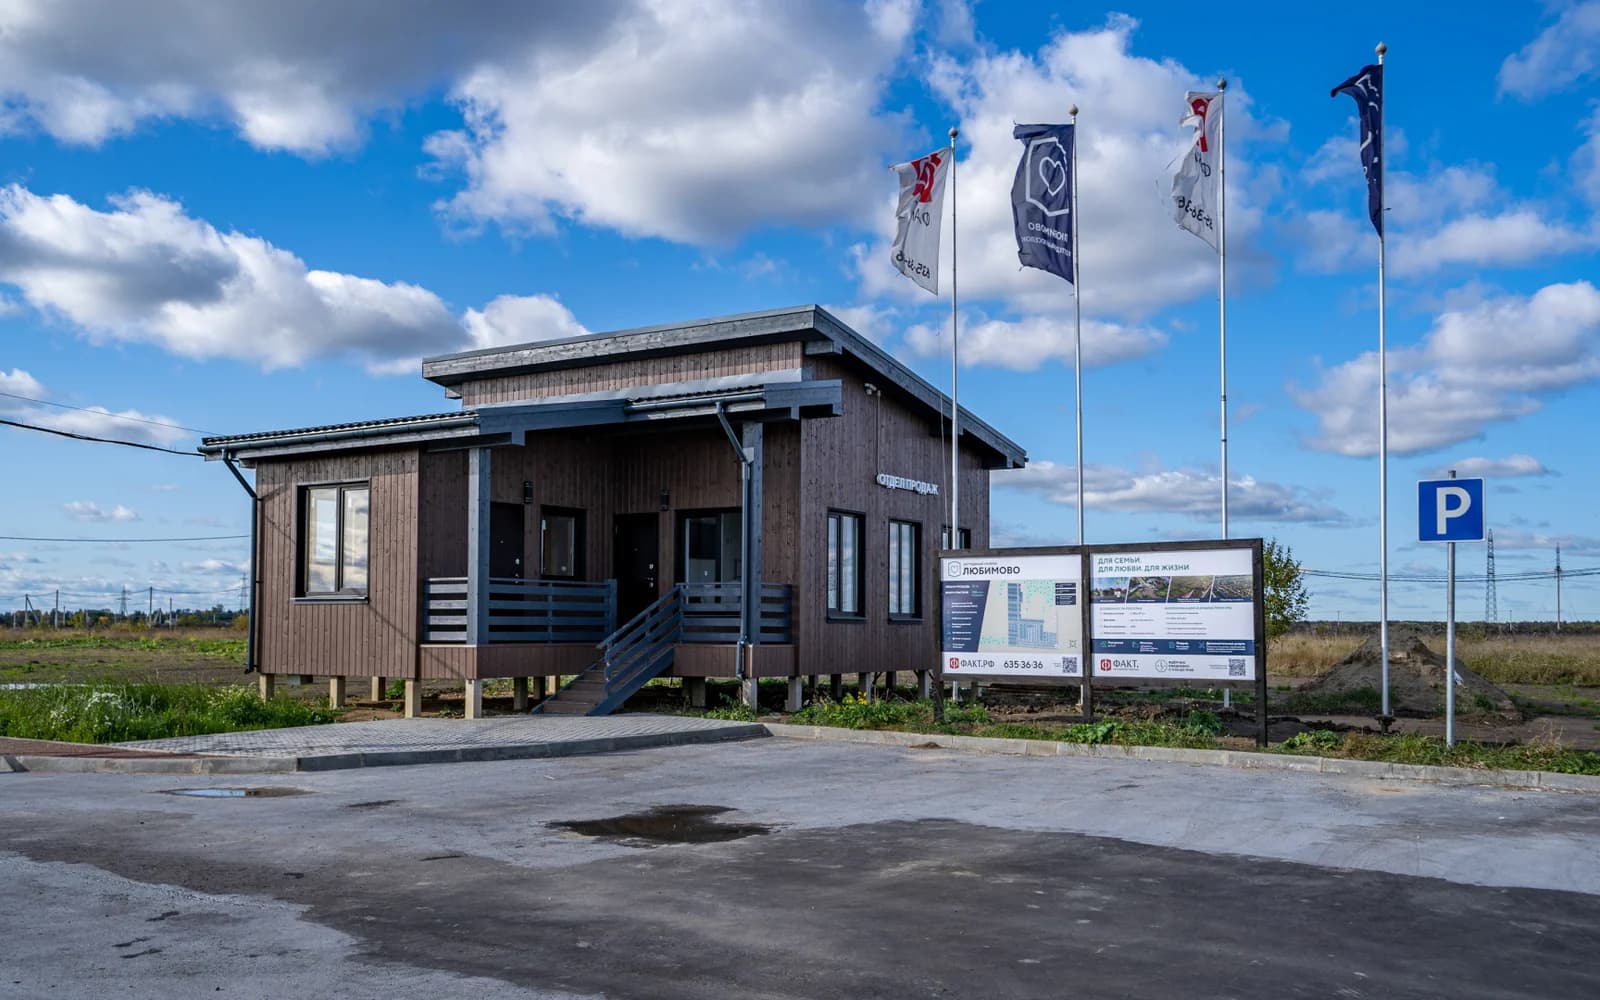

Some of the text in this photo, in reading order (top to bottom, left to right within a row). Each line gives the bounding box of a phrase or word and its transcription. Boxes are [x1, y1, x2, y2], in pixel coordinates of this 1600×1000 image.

[1436, 486, 1471, 535] P
[1098, 557, 1113, 565] ДЛЯ
[962, 566, 1021, 575] ЛЮБИМОВО
[1098, 565, 1113, 573] ДЛЯ
